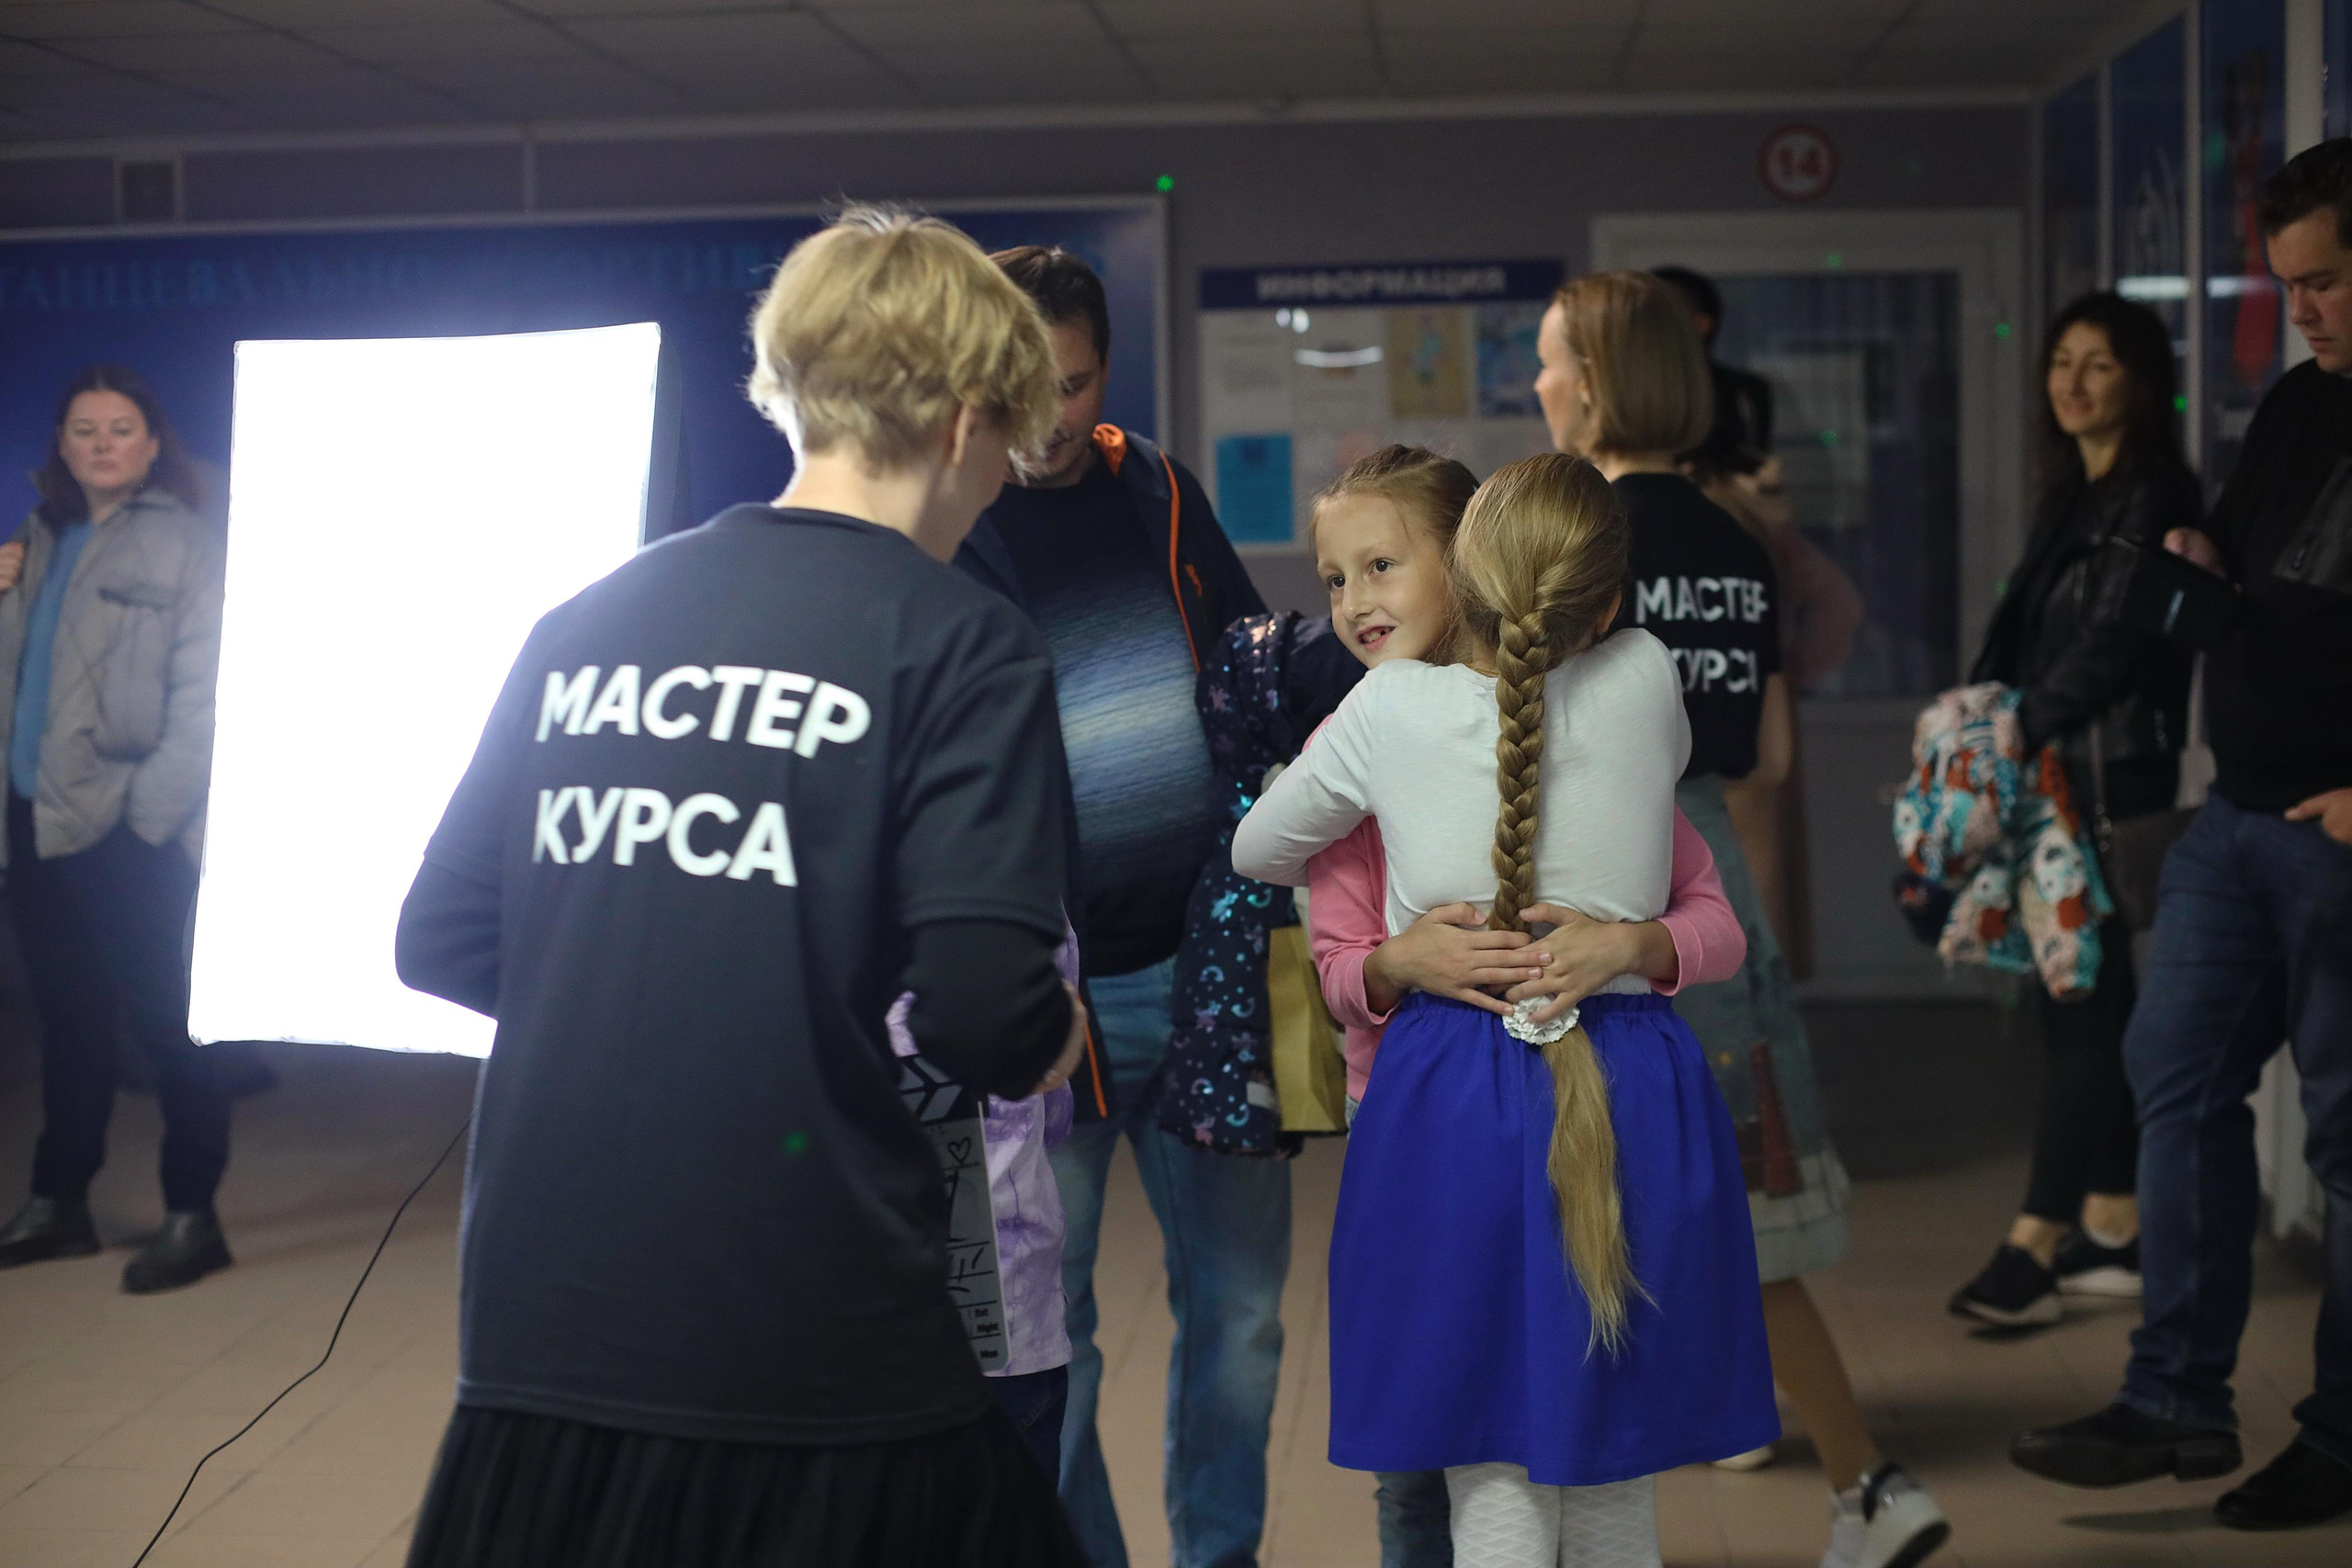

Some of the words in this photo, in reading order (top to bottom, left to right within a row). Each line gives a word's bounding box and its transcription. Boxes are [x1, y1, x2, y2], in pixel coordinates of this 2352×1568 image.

[1256, 266, 1506, 301] ИНФОРМАЦИЯ
[535, 664, 872, 760] МАСТЕР
[532, 785, 798, 887] КУРСА
